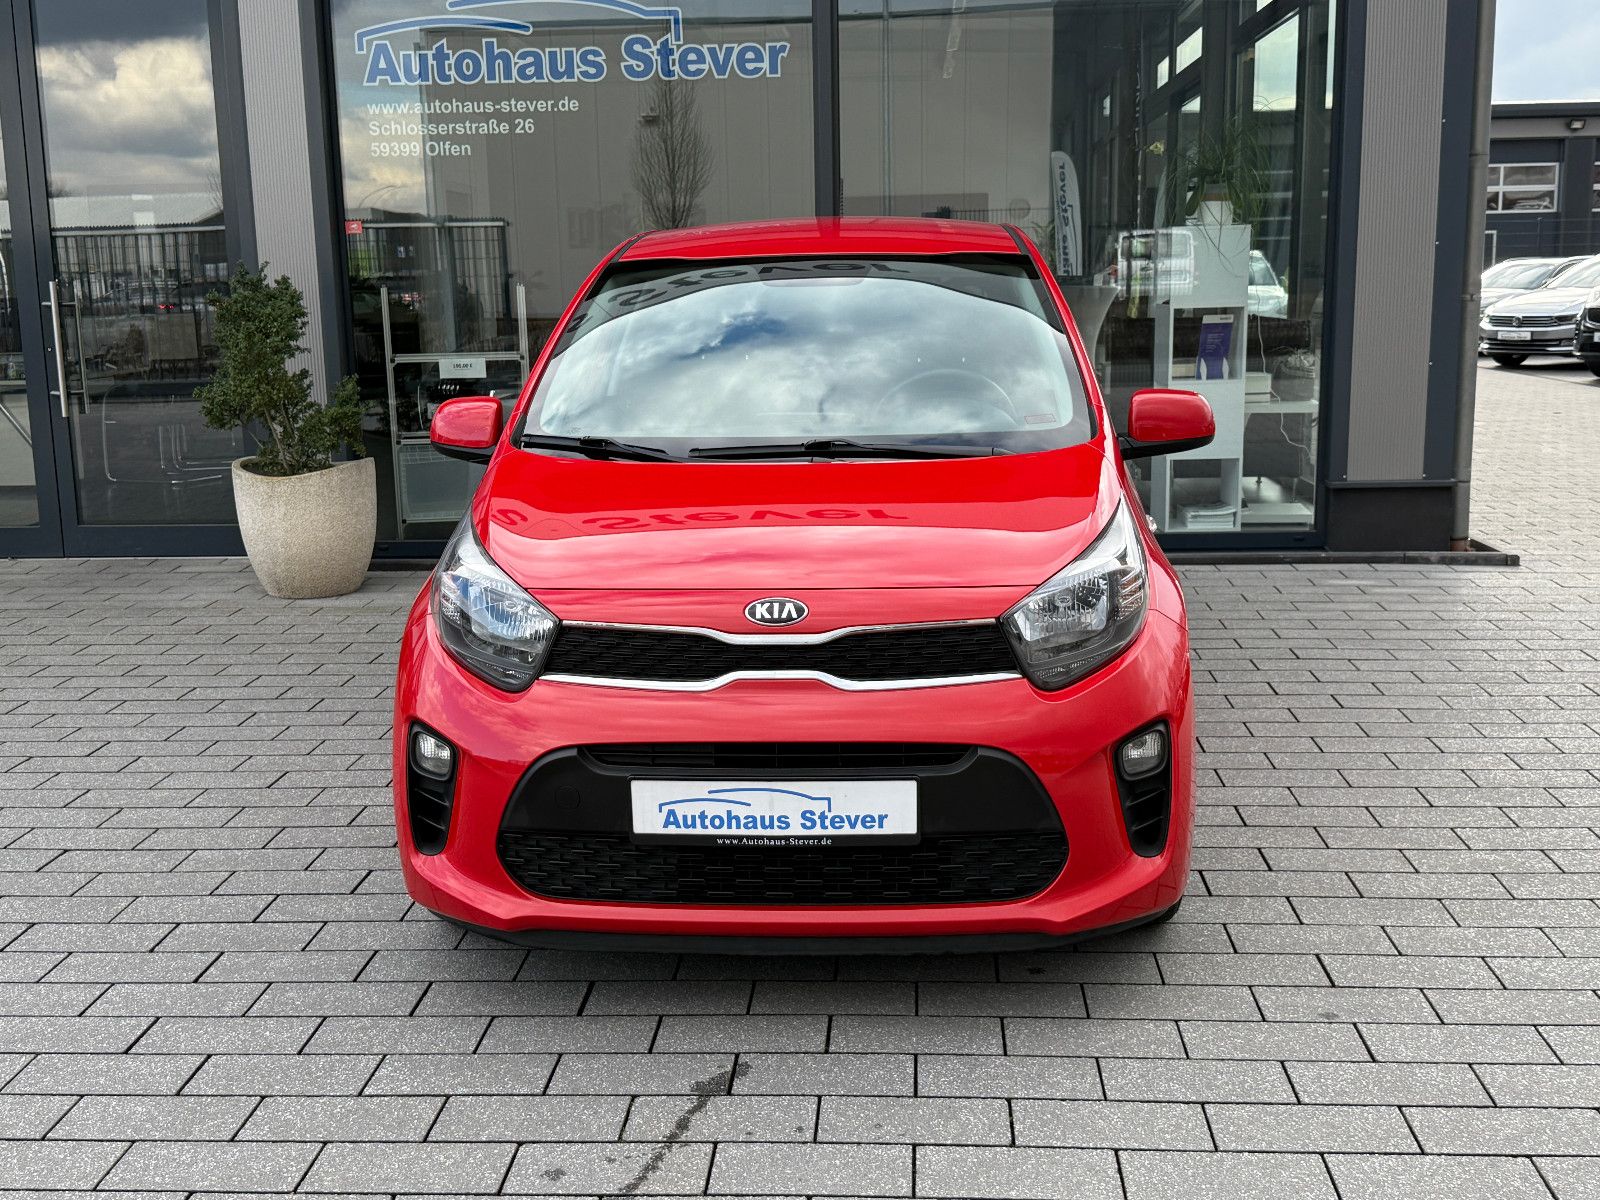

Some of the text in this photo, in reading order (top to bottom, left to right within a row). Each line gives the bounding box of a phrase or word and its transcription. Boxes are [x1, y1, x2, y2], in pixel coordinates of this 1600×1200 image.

[363, 33, 790, 86] Autohaus Stever
[366, 96, 579, 115] www.autohaus-stever.de
[368, 118, 535, 136] Schlosserstraße 26
[370, 141, 472, 157] 59399 Olfen
[755, 603, 798, 619] KIA
[662, 809, 888, 830] Autohaus Stever
[716, 837, 833, 846] www.Autohaus-Stever.de
